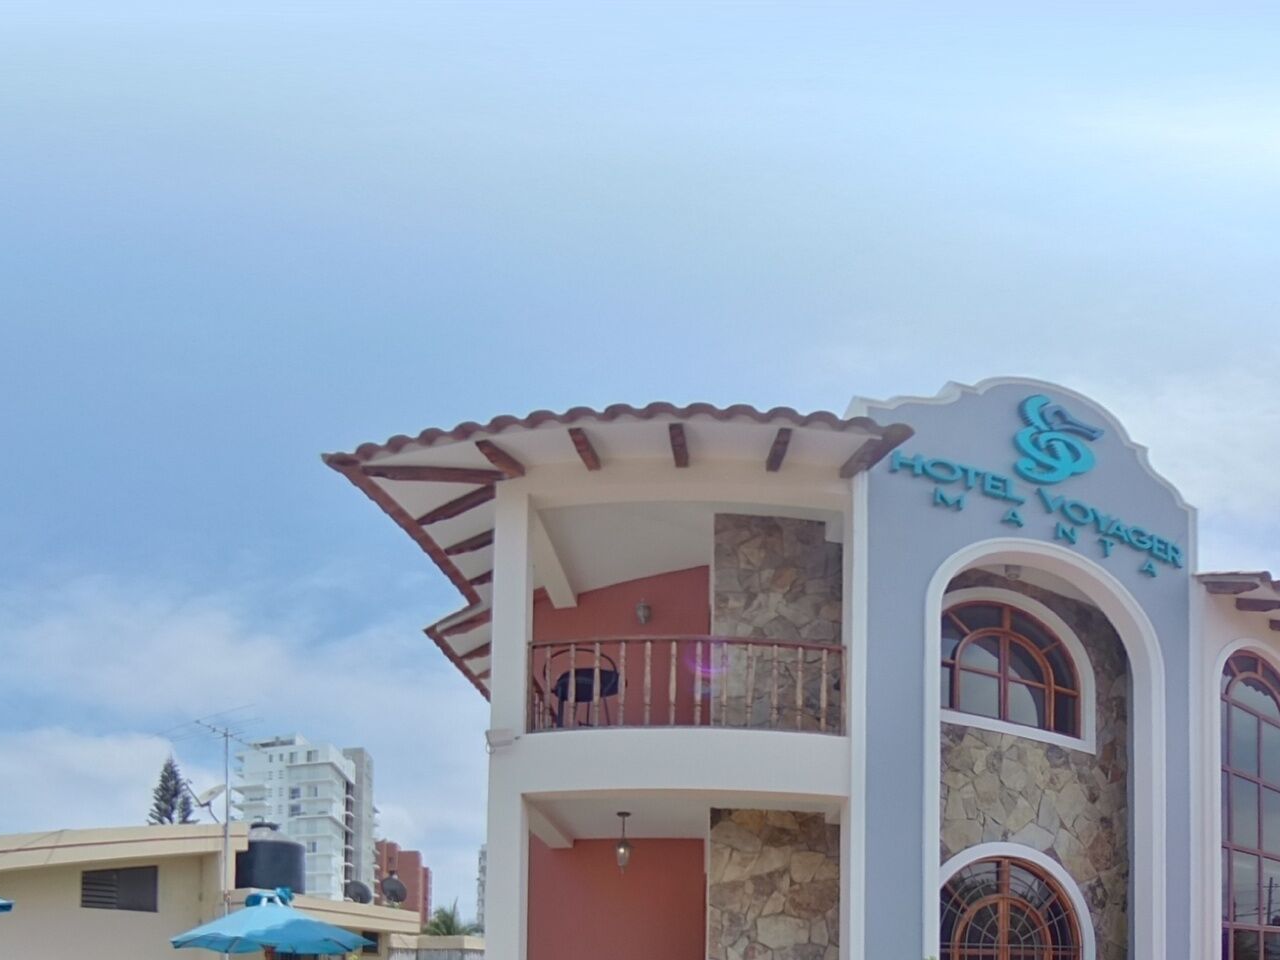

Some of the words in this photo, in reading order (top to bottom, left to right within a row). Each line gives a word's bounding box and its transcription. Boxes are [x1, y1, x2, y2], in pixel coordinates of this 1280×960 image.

[888, 451, 1025, 505] HOTEL
[1036, 487, 1184, 568] VOYAGER
[932, 488, 1157, 577] MANTA
